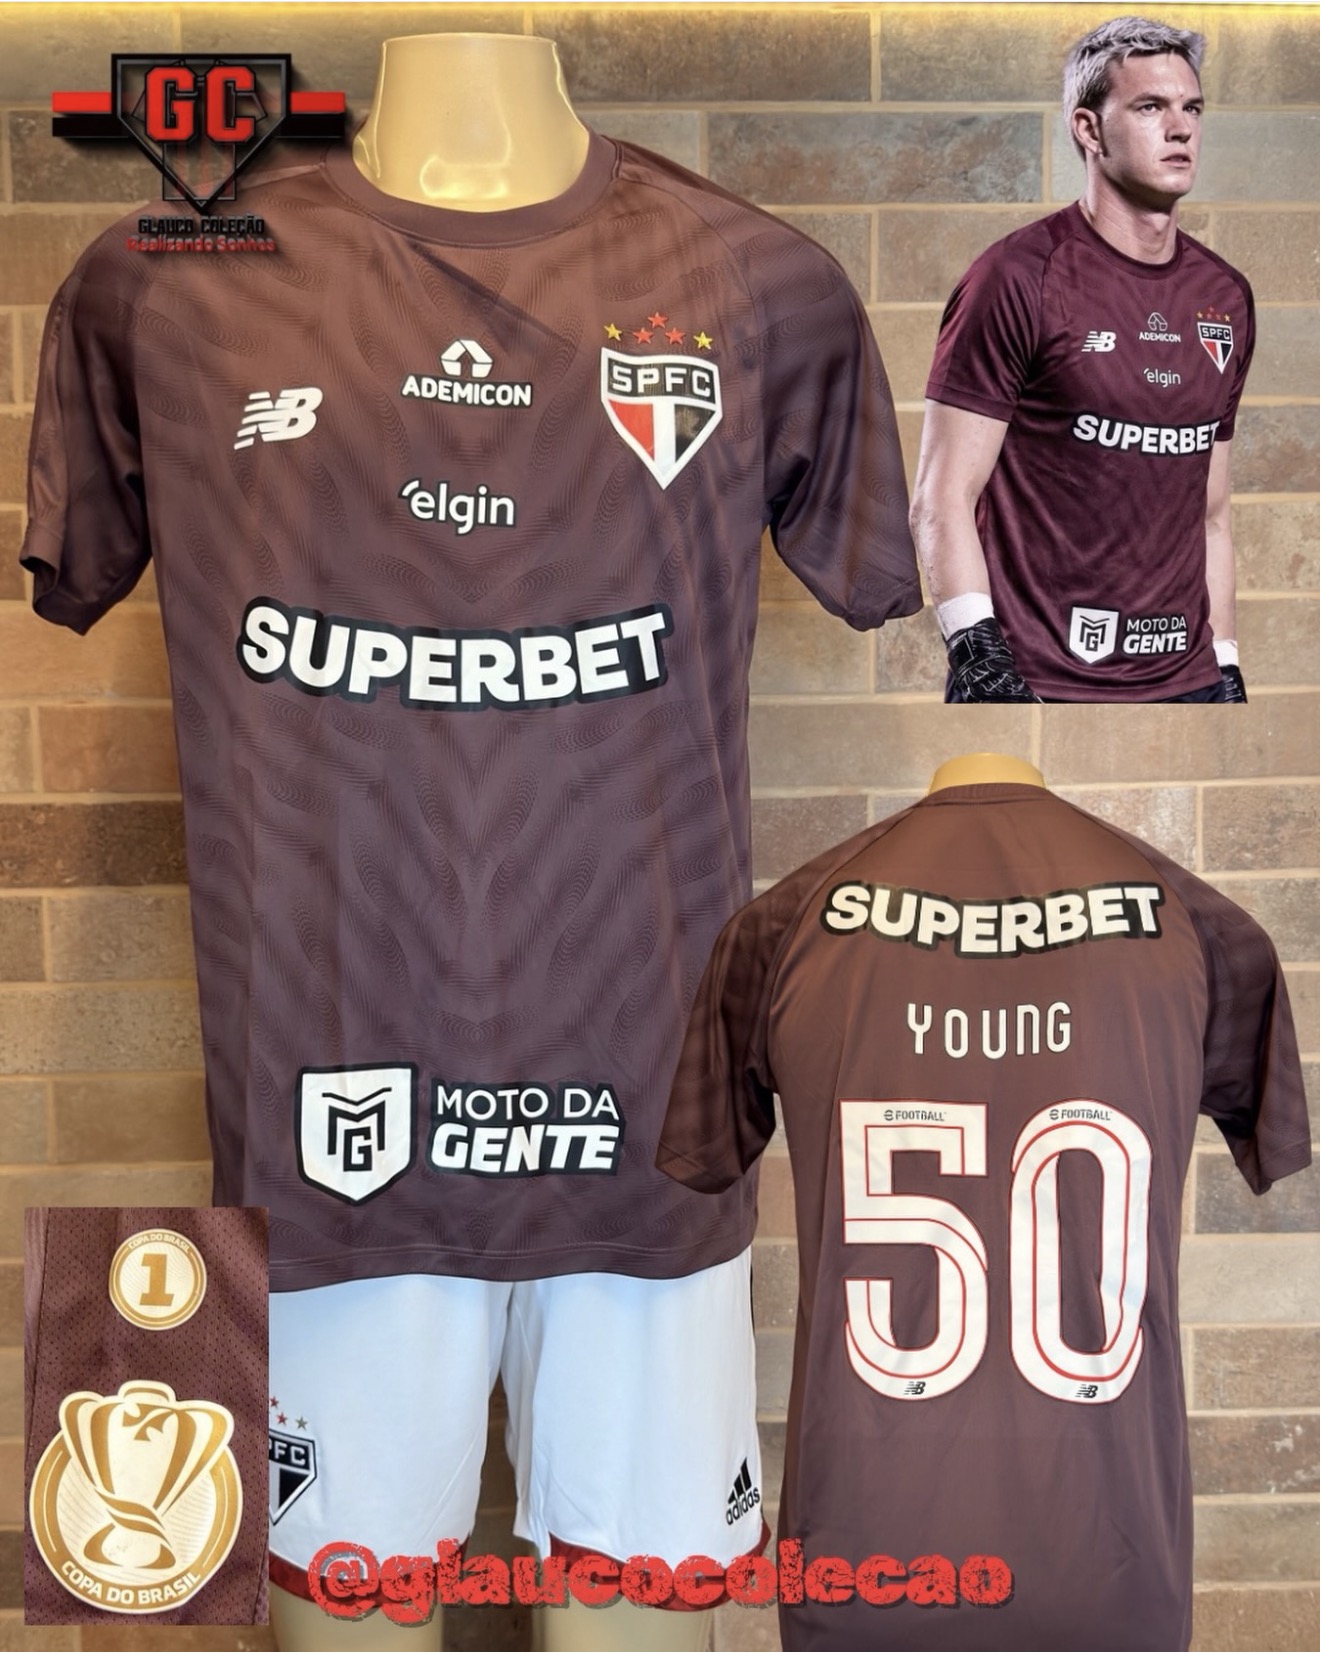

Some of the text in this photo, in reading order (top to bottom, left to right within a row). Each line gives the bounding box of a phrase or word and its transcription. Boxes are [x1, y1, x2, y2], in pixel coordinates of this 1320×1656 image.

[1138, 331, 1182, 343] ADEMICON
[1201, 327, 1231, 341] SPFC
[401, 375, 532, 406] ADEMICON
[611, 364, 712, 397] SPFC
[1073, 414, 1220, 454] SUPERBET
[1123, 631, 1187, 654] GENTE
[1126, 616, 1187, 632] MOTO DA
[242, 606, 666, 703] SUPERBET
[825, 885, 1160, 953] SUPERBET
[907, 1002, 1072, 1060] YOUNG
[436, 1085, 620, 1121] MOTO DA
[431, 1122, 620, 1172] GENTE
[128, 1235, 150, 1249] COPA
[163, 1234, 191, 1253] BRASIL
[840, 1099, 1152, 1404] 50
[139, 1253, 175, 1306] 1
[726, 1487, 760, 1525] adidas
[61, 1560, 202, 1605] COPA DO BRASIL
